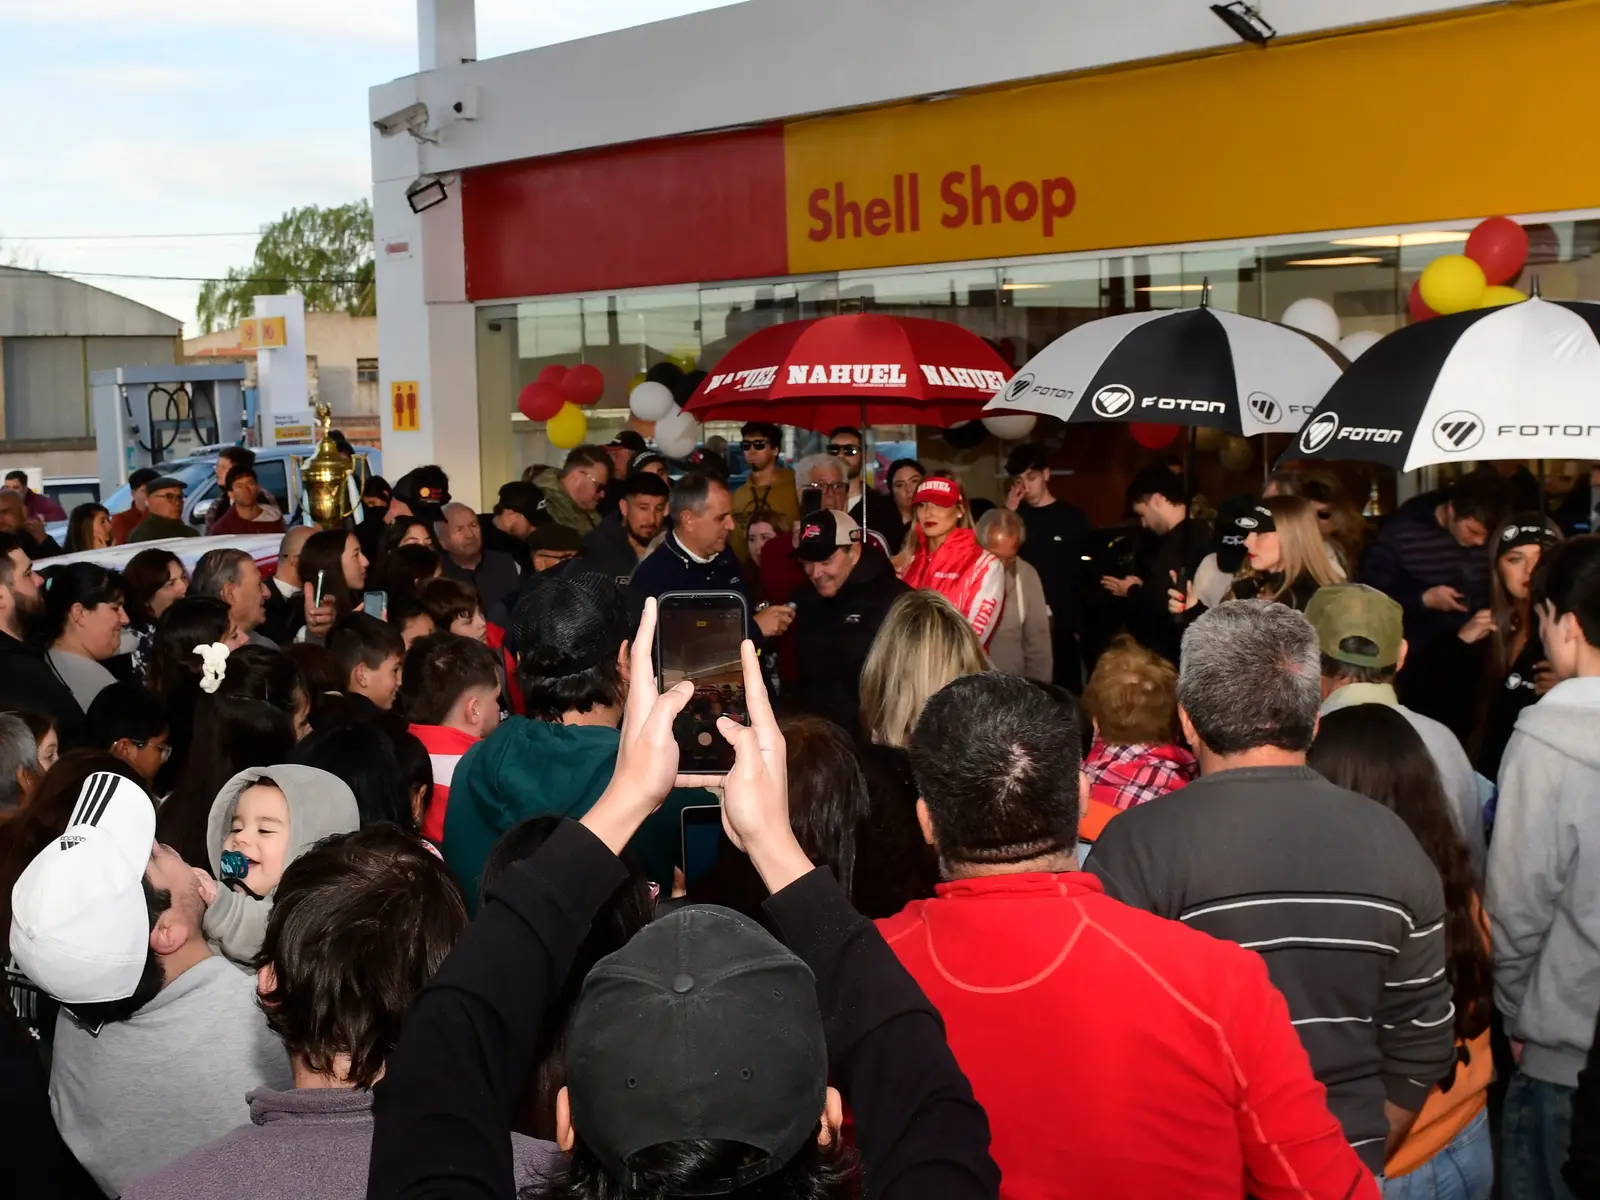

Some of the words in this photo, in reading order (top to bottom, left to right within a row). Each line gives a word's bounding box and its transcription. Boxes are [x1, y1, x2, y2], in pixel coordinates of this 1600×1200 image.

[808, 172, 920, 242] Shell
[940, 164, 1076, 237] Shop
[787, 364, 907, 384] NAHUEL
[1031, 386, 1074, 400] FOTON
[1141, 396, 1226, 414] FOTON
[1337, 427, 1403, 443] FOTON
